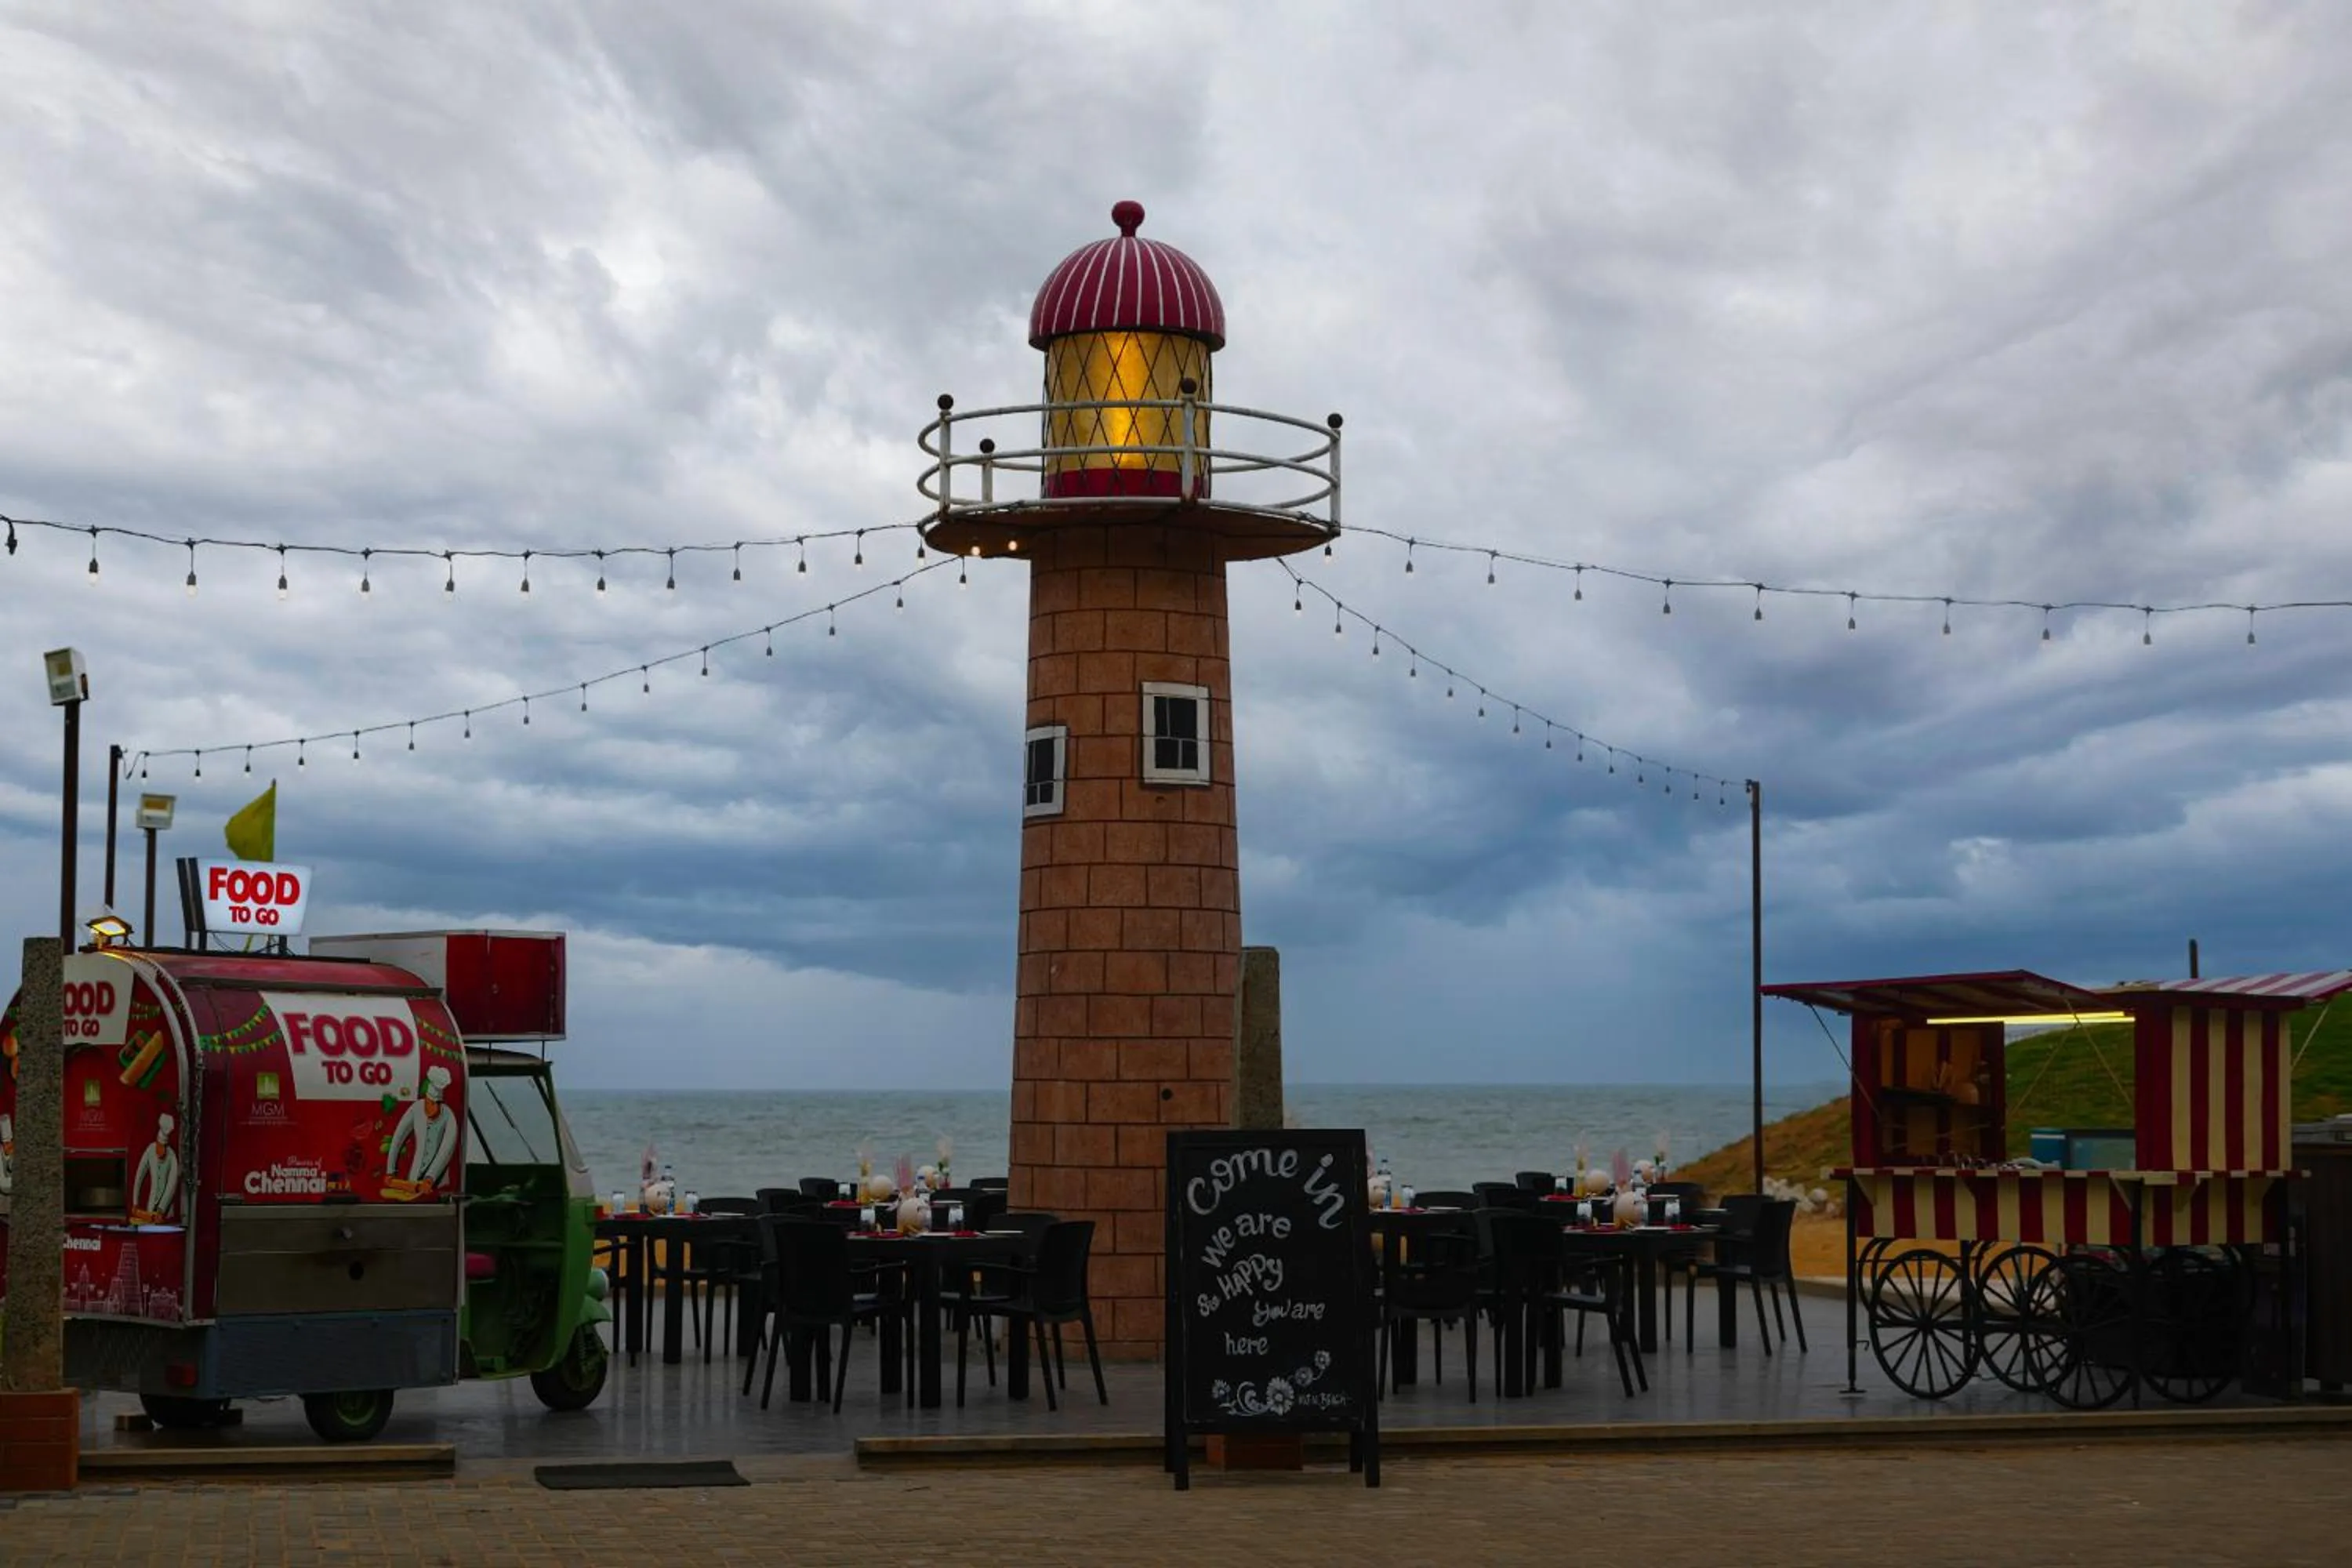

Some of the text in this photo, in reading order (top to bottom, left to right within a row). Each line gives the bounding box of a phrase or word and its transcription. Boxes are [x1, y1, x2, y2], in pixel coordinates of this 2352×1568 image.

[209, 867, 300, 906] FOOD
[228, 906, 280, 926] TO GO
[64, 982, 115, 1016] OOD
[64, 1018, 100, 1036] TO GO
[281, 1013, 414, 1058] FOOD
[321, 1061, 393, 1086] TO GO
[251, 1102, 285, 1116] MGM
[270, 1163, 318, 1177] Namma
[1186, 1148, 1299, 1215] Come
[244, 1171, 328, 1195] Chennai
[1234, 1213, 1292, 1240] are
[63, 1233, 102, 1252] hennai
[1252, 1298, 1327, 1327] you are
[1224, 1331, 1269, 1356] here
